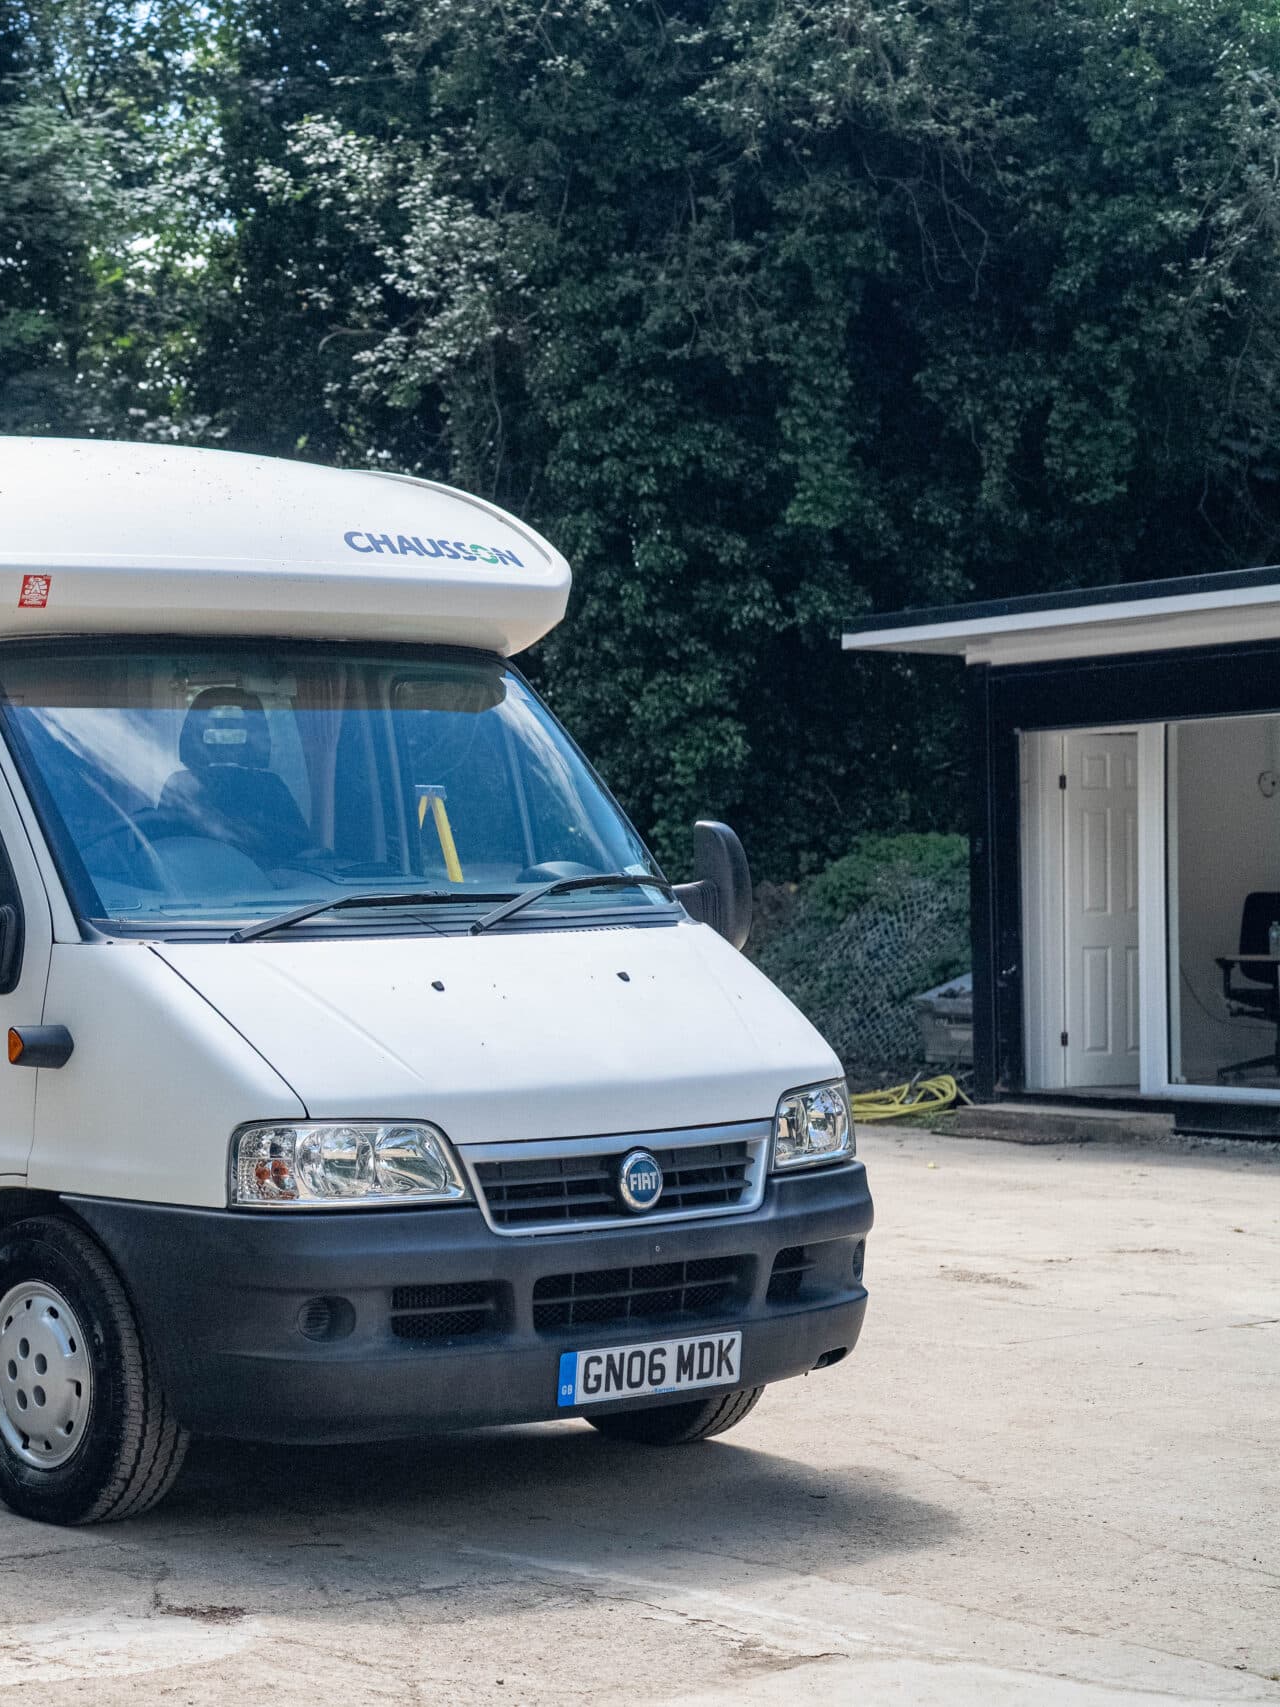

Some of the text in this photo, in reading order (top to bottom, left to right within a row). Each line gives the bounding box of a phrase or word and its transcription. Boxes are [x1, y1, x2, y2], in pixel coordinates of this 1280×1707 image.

[344, 531, 525, 568] CHAUSSON
[630, 1172, 657, 1191] FIAT
[583, 1338, 736, 1395] GN06 MDK
[561, 1384, 573, 1395] GB
